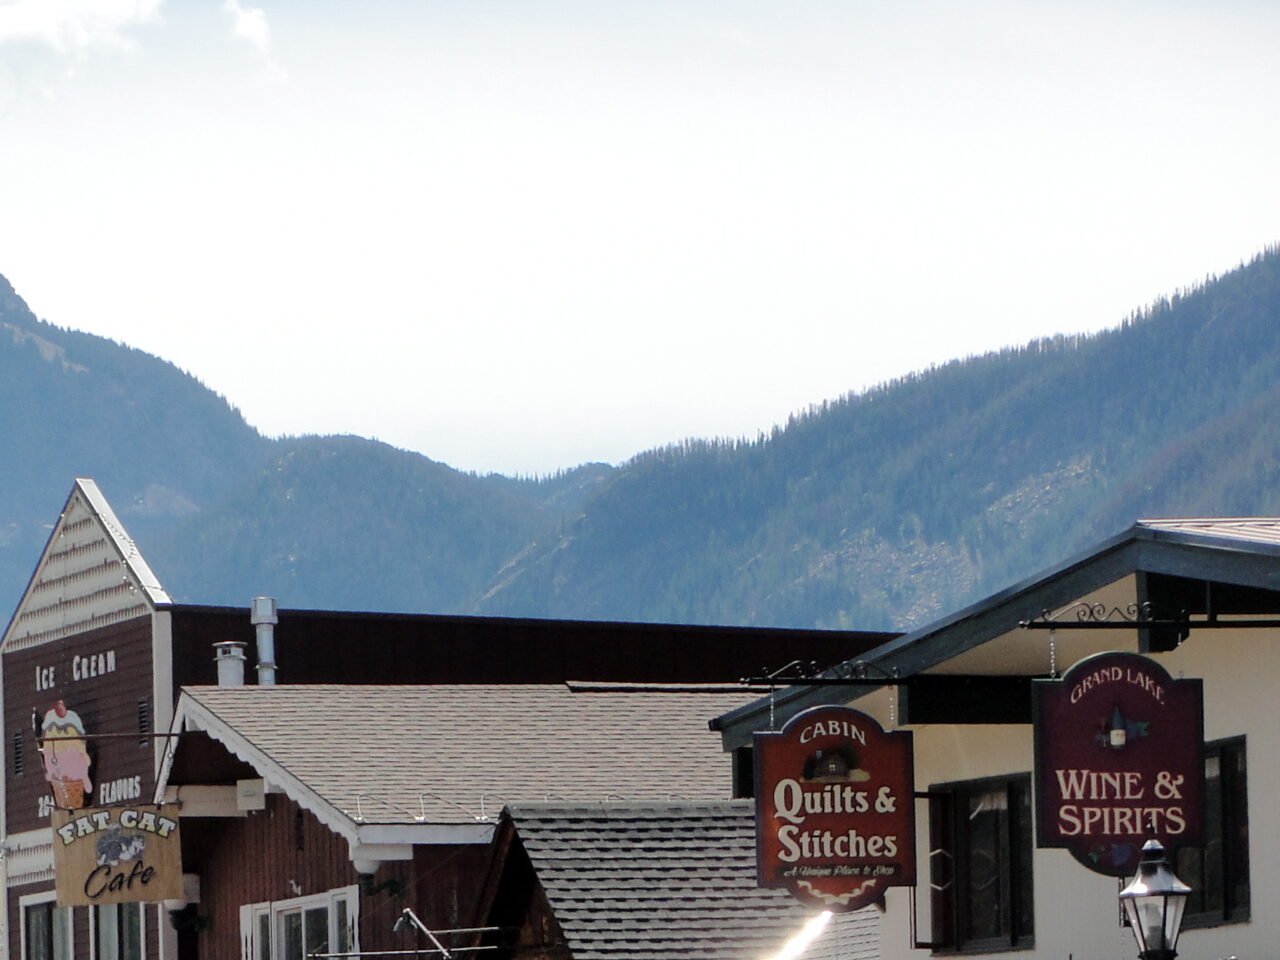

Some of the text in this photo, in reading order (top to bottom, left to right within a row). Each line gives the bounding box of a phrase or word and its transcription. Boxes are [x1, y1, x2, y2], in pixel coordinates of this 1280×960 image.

[1071, 667, 1165, 704] GRAND LAKE
[800, 720, 866, 746] CABIN
[99, 776, 141, 805] FLAVORS
[774, 778, 897, 824] Quilts &
[1055, 769, 1184, 800] WINE &
[57, 809, 178, 846] FAT CAT
[1058, 804, 1186, 836] SPIRITS
[777, 824, 898, 862] Stitches
[84, 858, 158, 899] Cafe
[784, 866, 797, 877] A
[799, 865, 831, 877] Unique
[833, 865, 860, 876] Place
